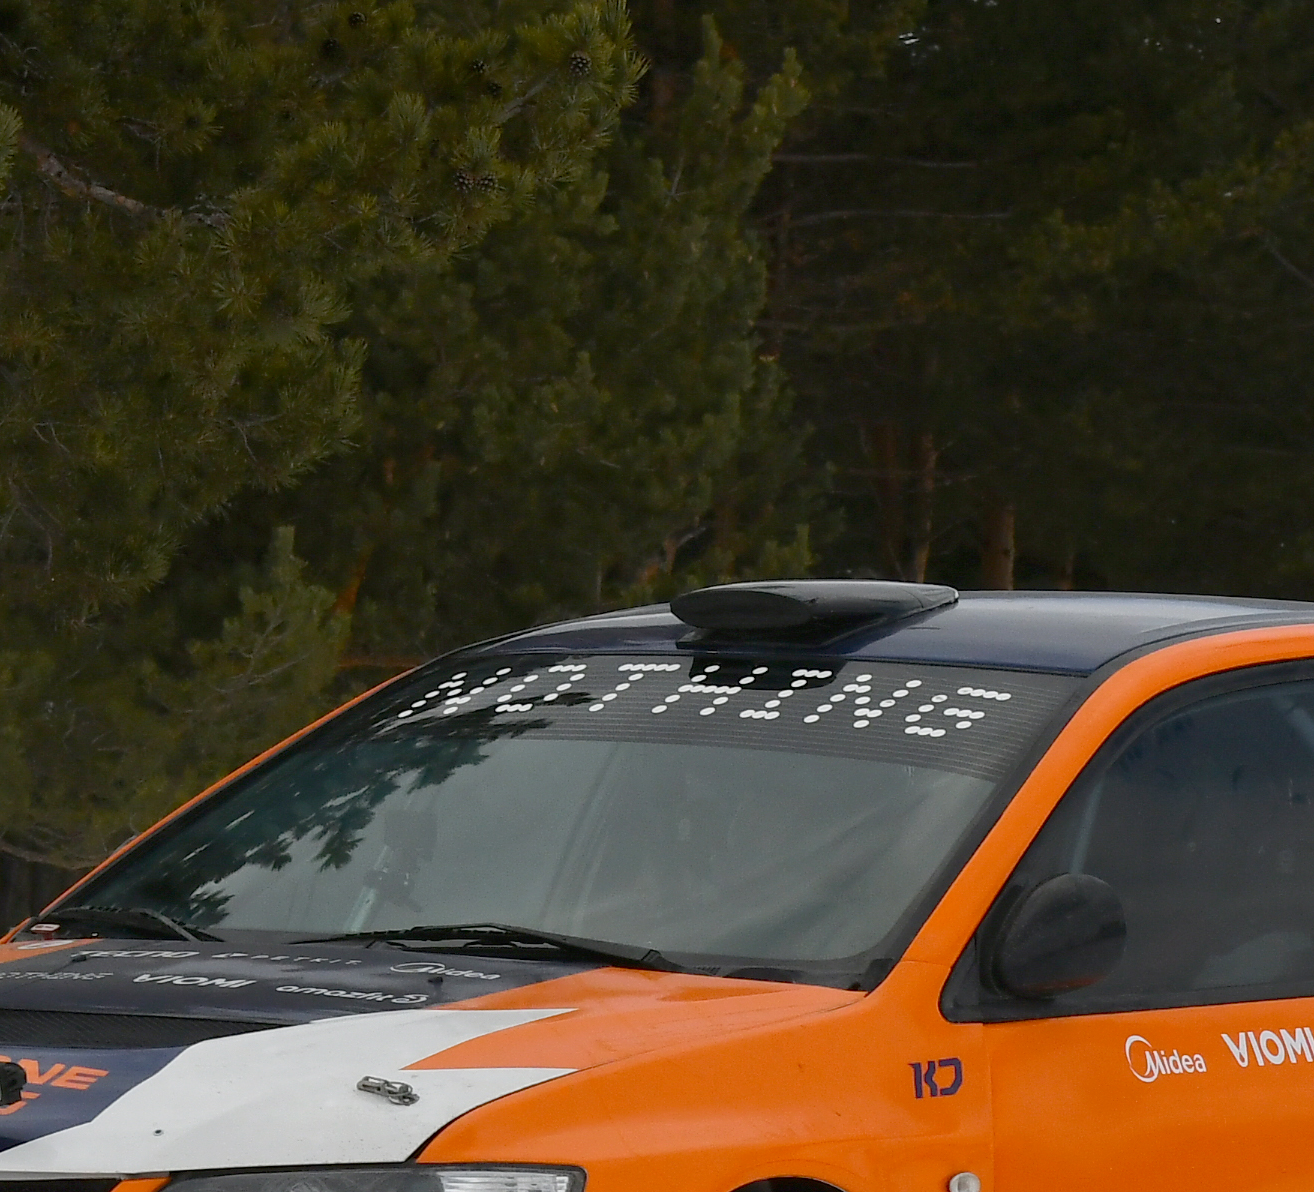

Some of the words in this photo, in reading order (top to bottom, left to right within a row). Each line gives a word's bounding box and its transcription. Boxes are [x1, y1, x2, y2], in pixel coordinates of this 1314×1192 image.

[398, 664, 1012, 738] NOTHING
[390, 962, 502, 980] Midea
[133, 973, 258, 989] VIOMI
[276, 985, 396, 1002] amazfit
[1124, 1034, 1207, 1083] Midea
